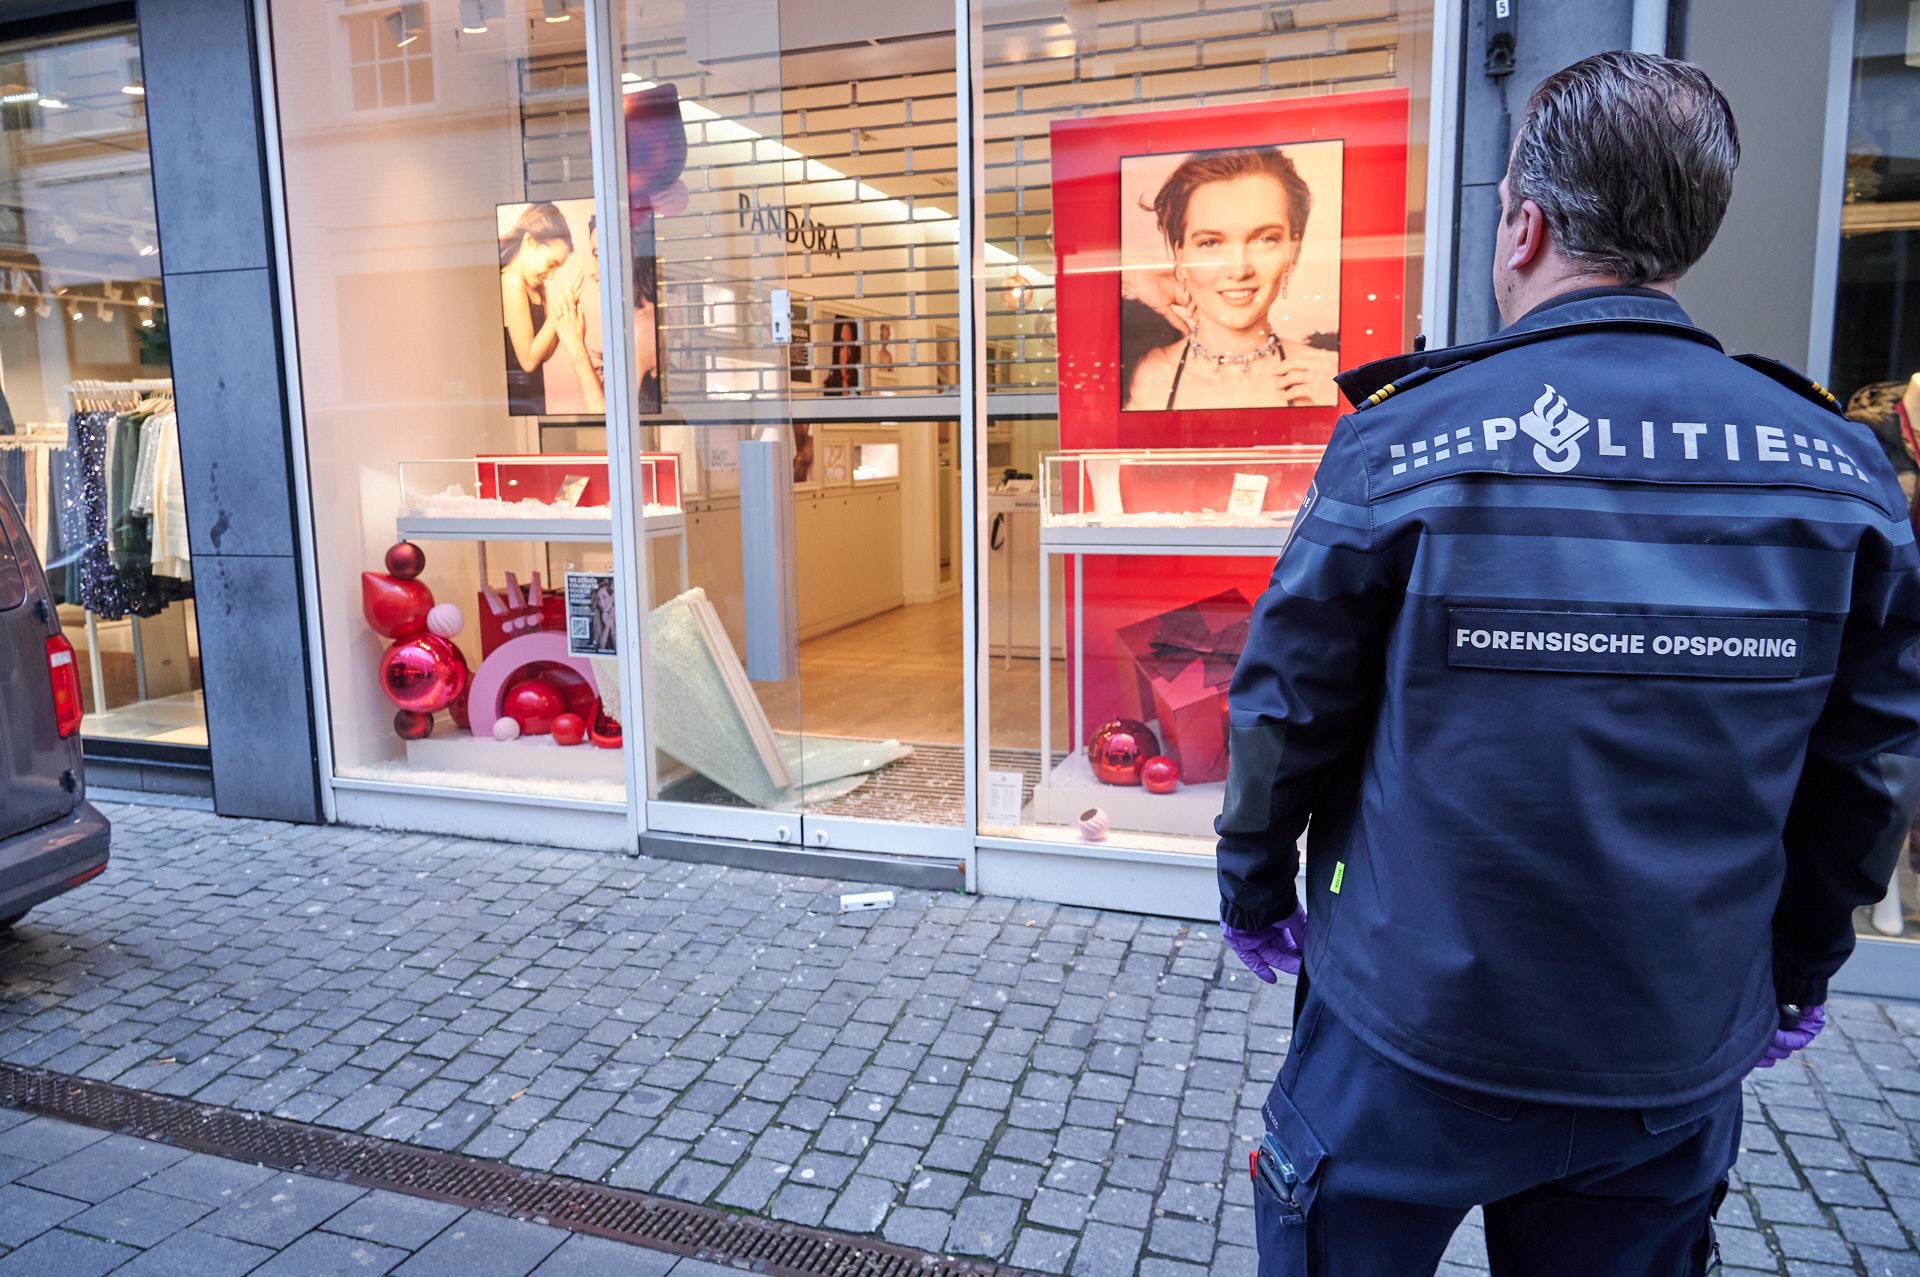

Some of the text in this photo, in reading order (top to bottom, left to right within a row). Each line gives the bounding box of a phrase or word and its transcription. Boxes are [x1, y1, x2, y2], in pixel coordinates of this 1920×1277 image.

[738, 192, 841, 260] PANDORA
[1456, 629, 1797, 658] FORENSISCHE OPSPORING
